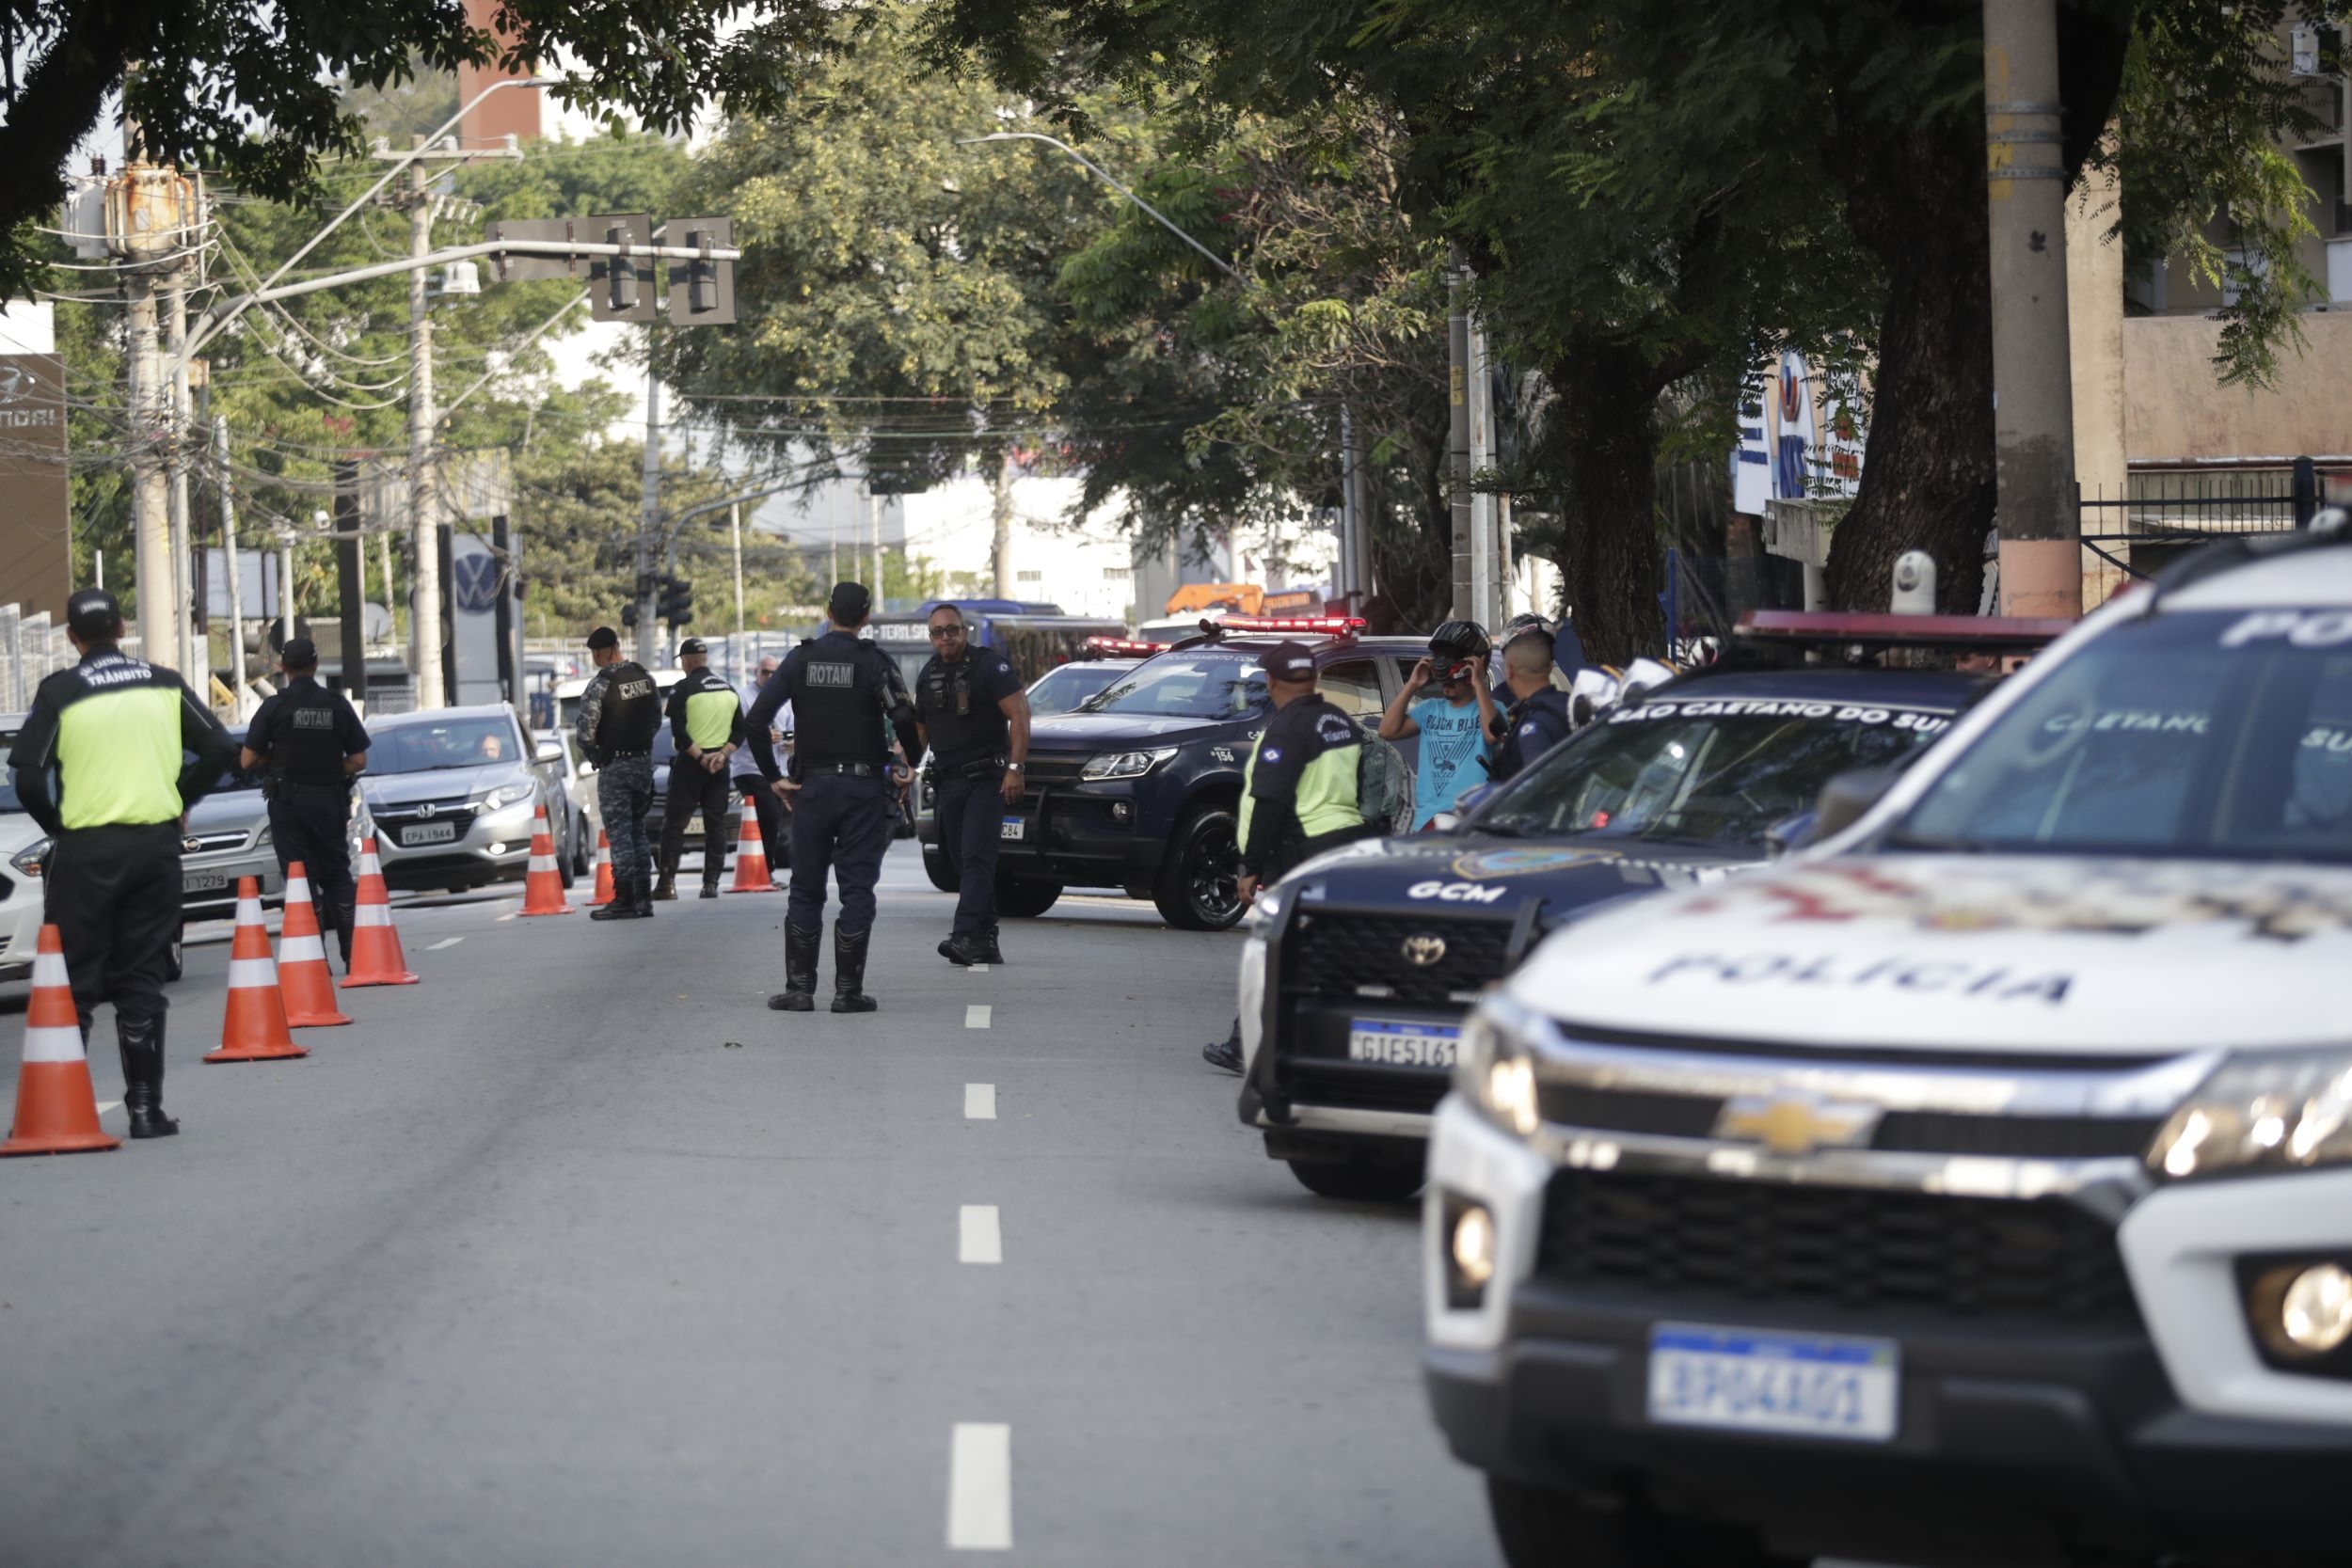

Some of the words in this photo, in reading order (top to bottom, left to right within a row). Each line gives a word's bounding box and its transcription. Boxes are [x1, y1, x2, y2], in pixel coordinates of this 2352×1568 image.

[809, 664, 851, 685] ROTAM
[622, 680, 651, 698] CANIL
[295, 710, 331, 726] ROTAM
[1680, 702, 1834, 719] CAETANO
[1835, 705, 1890, 723] DO
[1216, 751, 1234, 762] 156
[1407, 881, 1507, 903] GCM
